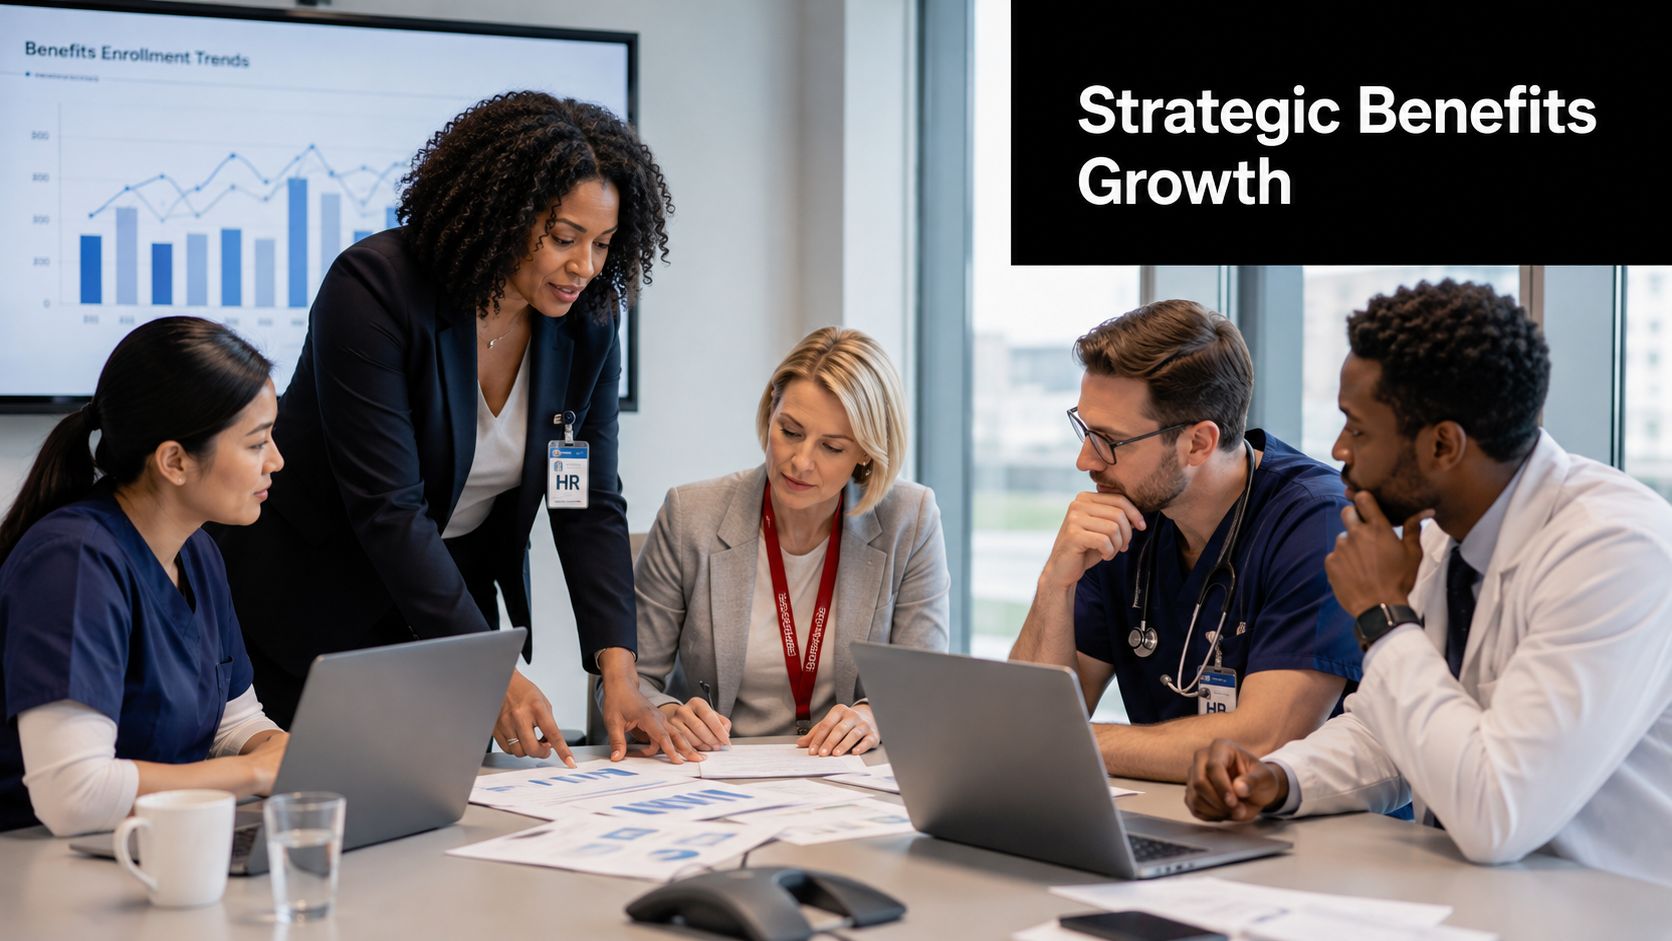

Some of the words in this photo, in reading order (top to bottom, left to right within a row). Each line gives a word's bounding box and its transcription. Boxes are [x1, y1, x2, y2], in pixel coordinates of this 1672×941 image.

[25, 41, 96, 59] Benefits
[101, 45, 190, 65] Enrollment
[195, 50, 249, 68] Trends
[556, 474, 580, 490] HR
